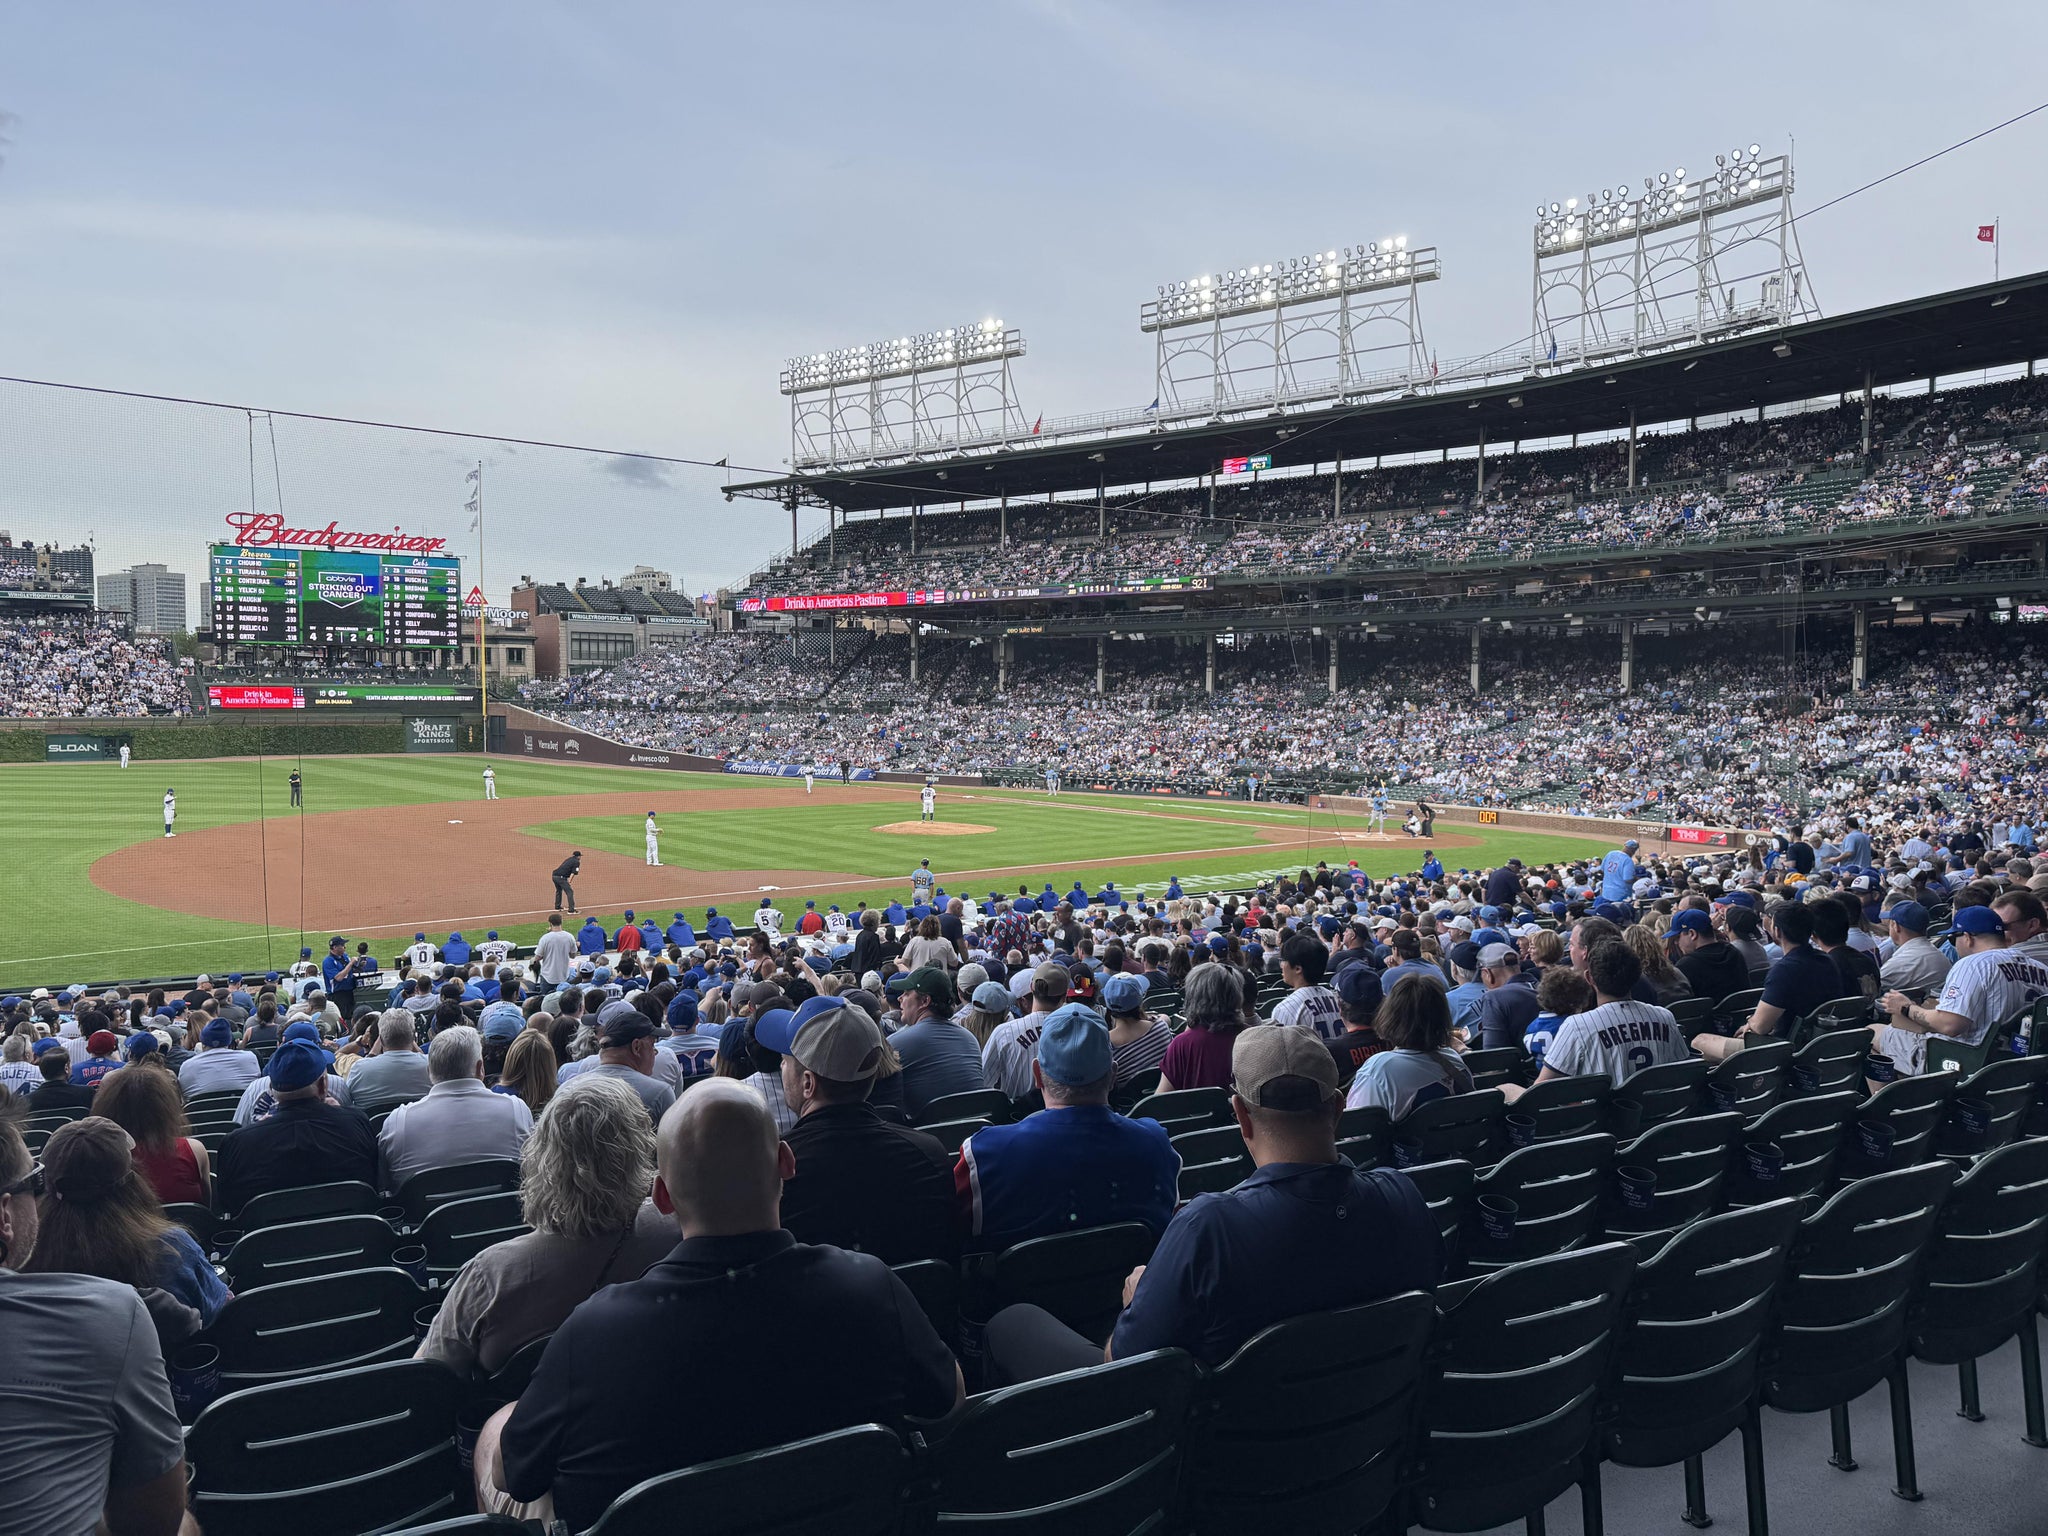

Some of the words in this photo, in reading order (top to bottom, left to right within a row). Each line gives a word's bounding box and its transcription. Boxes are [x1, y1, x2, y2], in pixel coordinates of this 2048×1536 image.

[226, 512, 447, 551] Budweiser
[241, 548, 271, 558] Brewers
[413, 558, 428, 567] Cubs
[309, 583, 353, 592] STRIKING
[355, 585, 374, 593] OUT
[322, 591, 360, 599] CANCER
[785, 597, 806, 609] Drink
[815, 595, 854, 608] America's
[855, 594, 889, 607] Pastime
[489, 608, 529, 619] Moore
[571, 613, 633, 622] WRIGLEYROOFTOPS.COM
[310, 632, 317, 641] 4
[326, 633, 333, 641] 2
[350, 634, 357, 642] 2
[366, 634, 374, 642] 4
[244, 690, 265, 698] Drink
[414, 724, 452, 733] DRAFT
[419, 730, 451, 738] KINGS
[637, 754, 658, 763] Invesco
[730, 763, 759, 774] Reynolds
[760, 764, 778, 776] Wrap
[762, 915, 769, 926] 5
[832, 917, 844, 927] 20
[420, 950, 427, 963] 0
[1997, 962, 2048, 989] BREGMA
[1598, 1021, 1670, 1050] BREGMAN
[1945, 1062, 1958, 1071] 13
